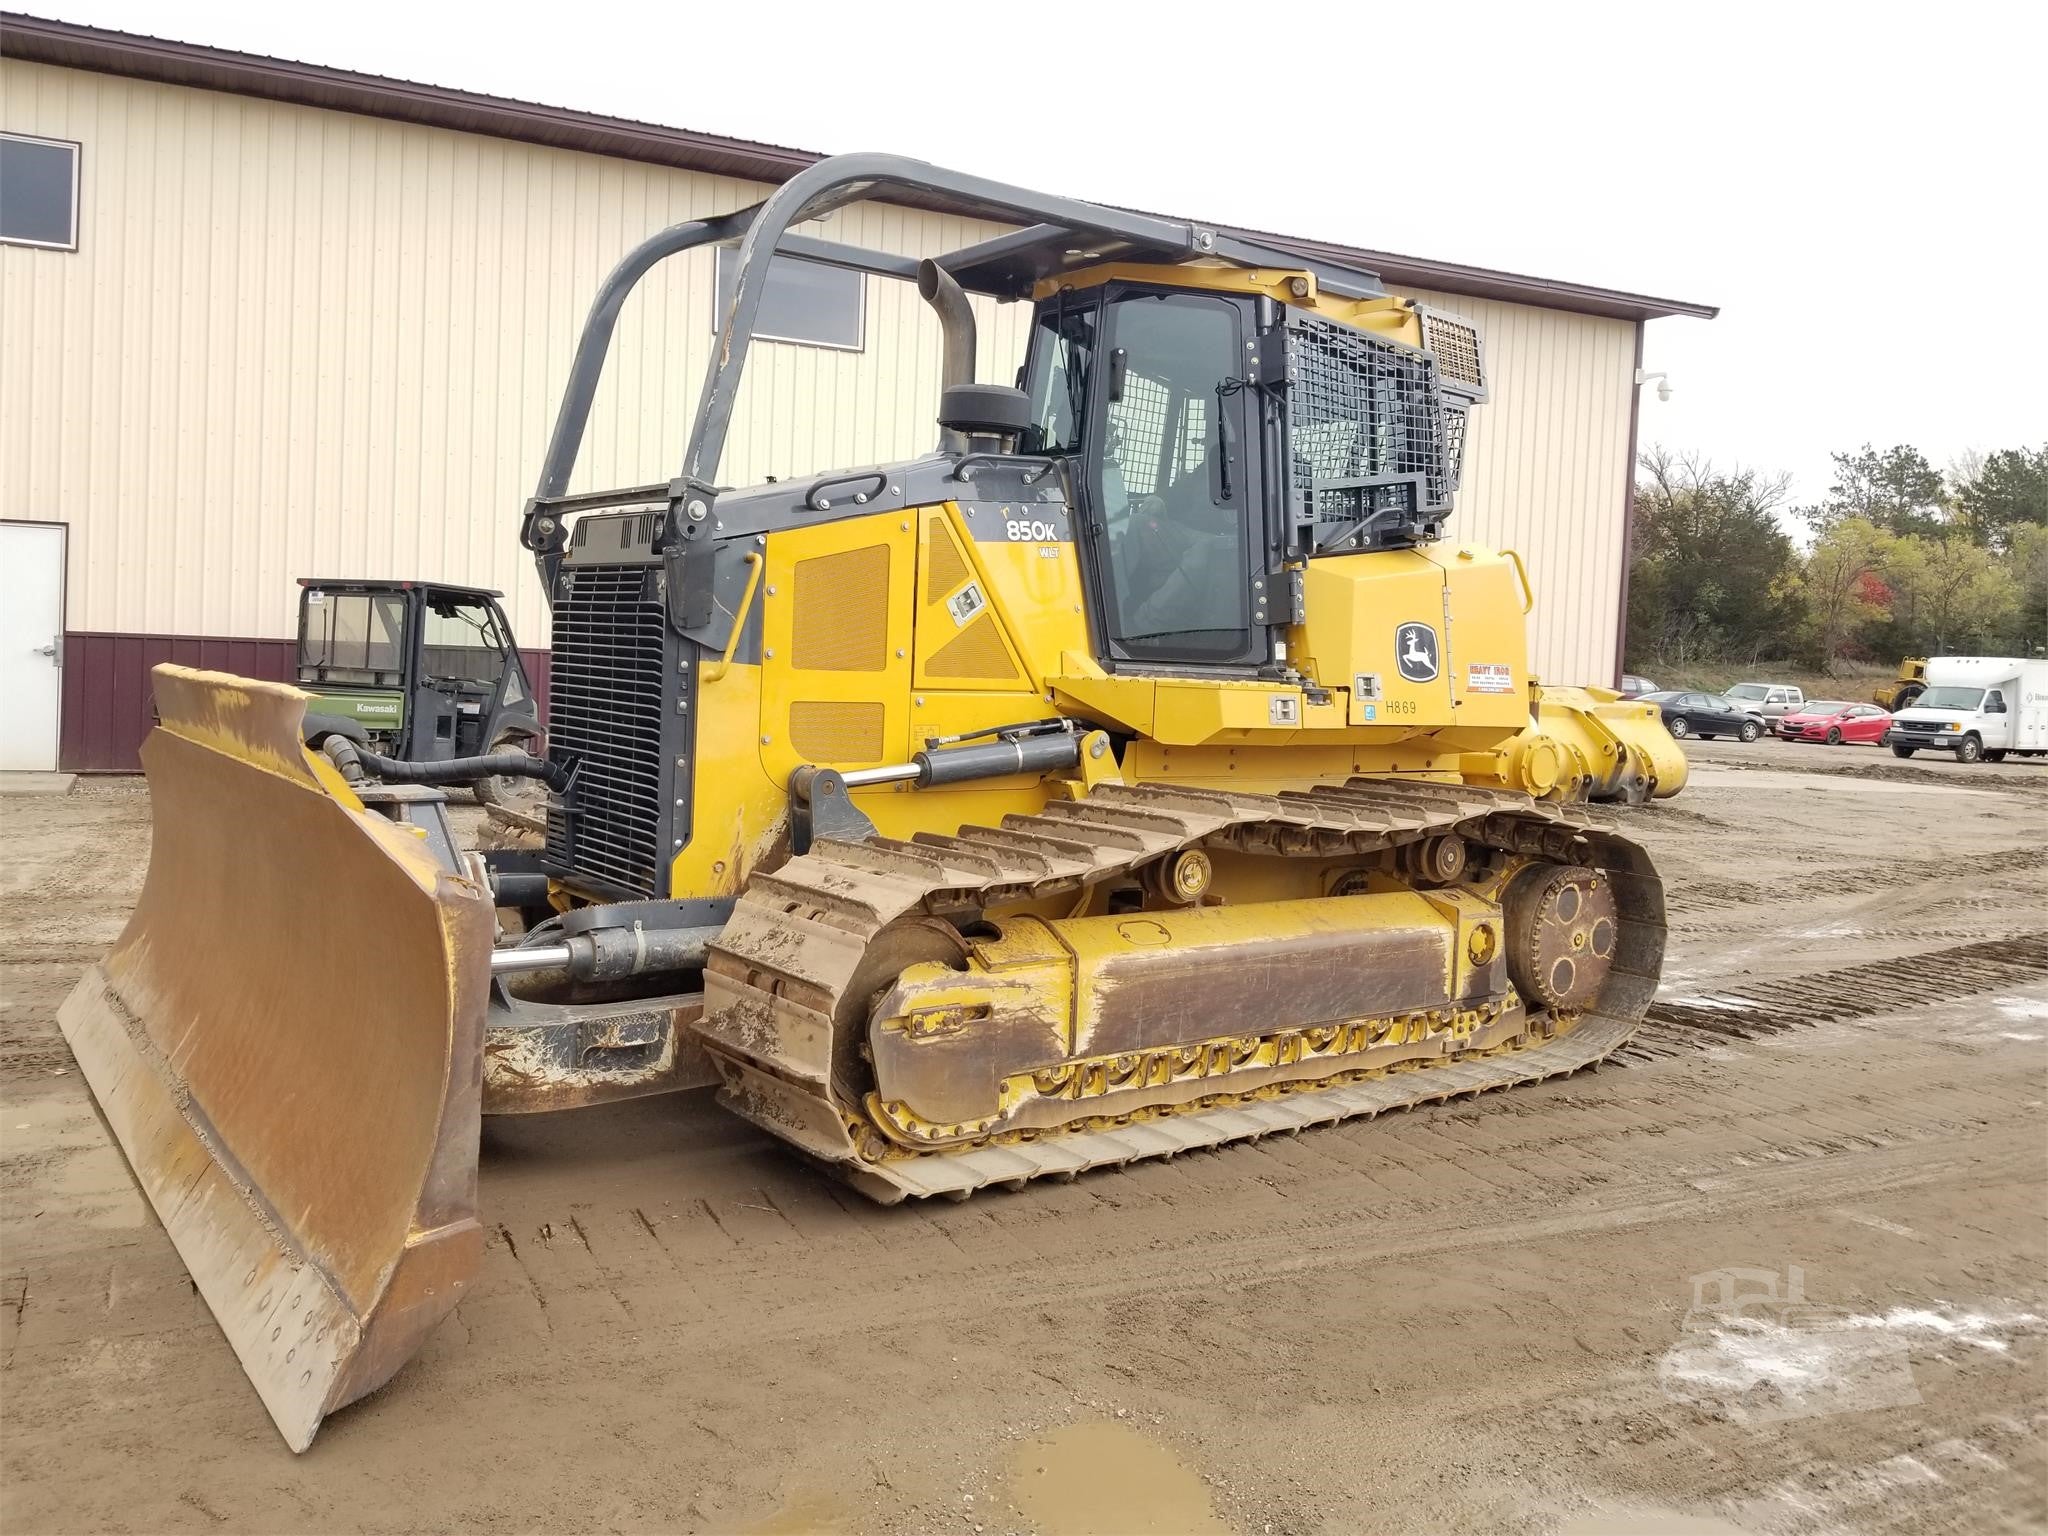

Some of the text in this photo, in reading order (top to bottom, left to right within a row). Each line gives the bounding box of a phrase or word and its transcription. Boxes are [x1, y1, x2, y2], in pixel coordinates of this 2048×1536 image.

[1006, 520, 1058, 541] 850K
[1039, 547, 1059, 558] WLT
[357, 703, 397, 713] Kawasaki
[1386, 701, 1416, 714] H869
